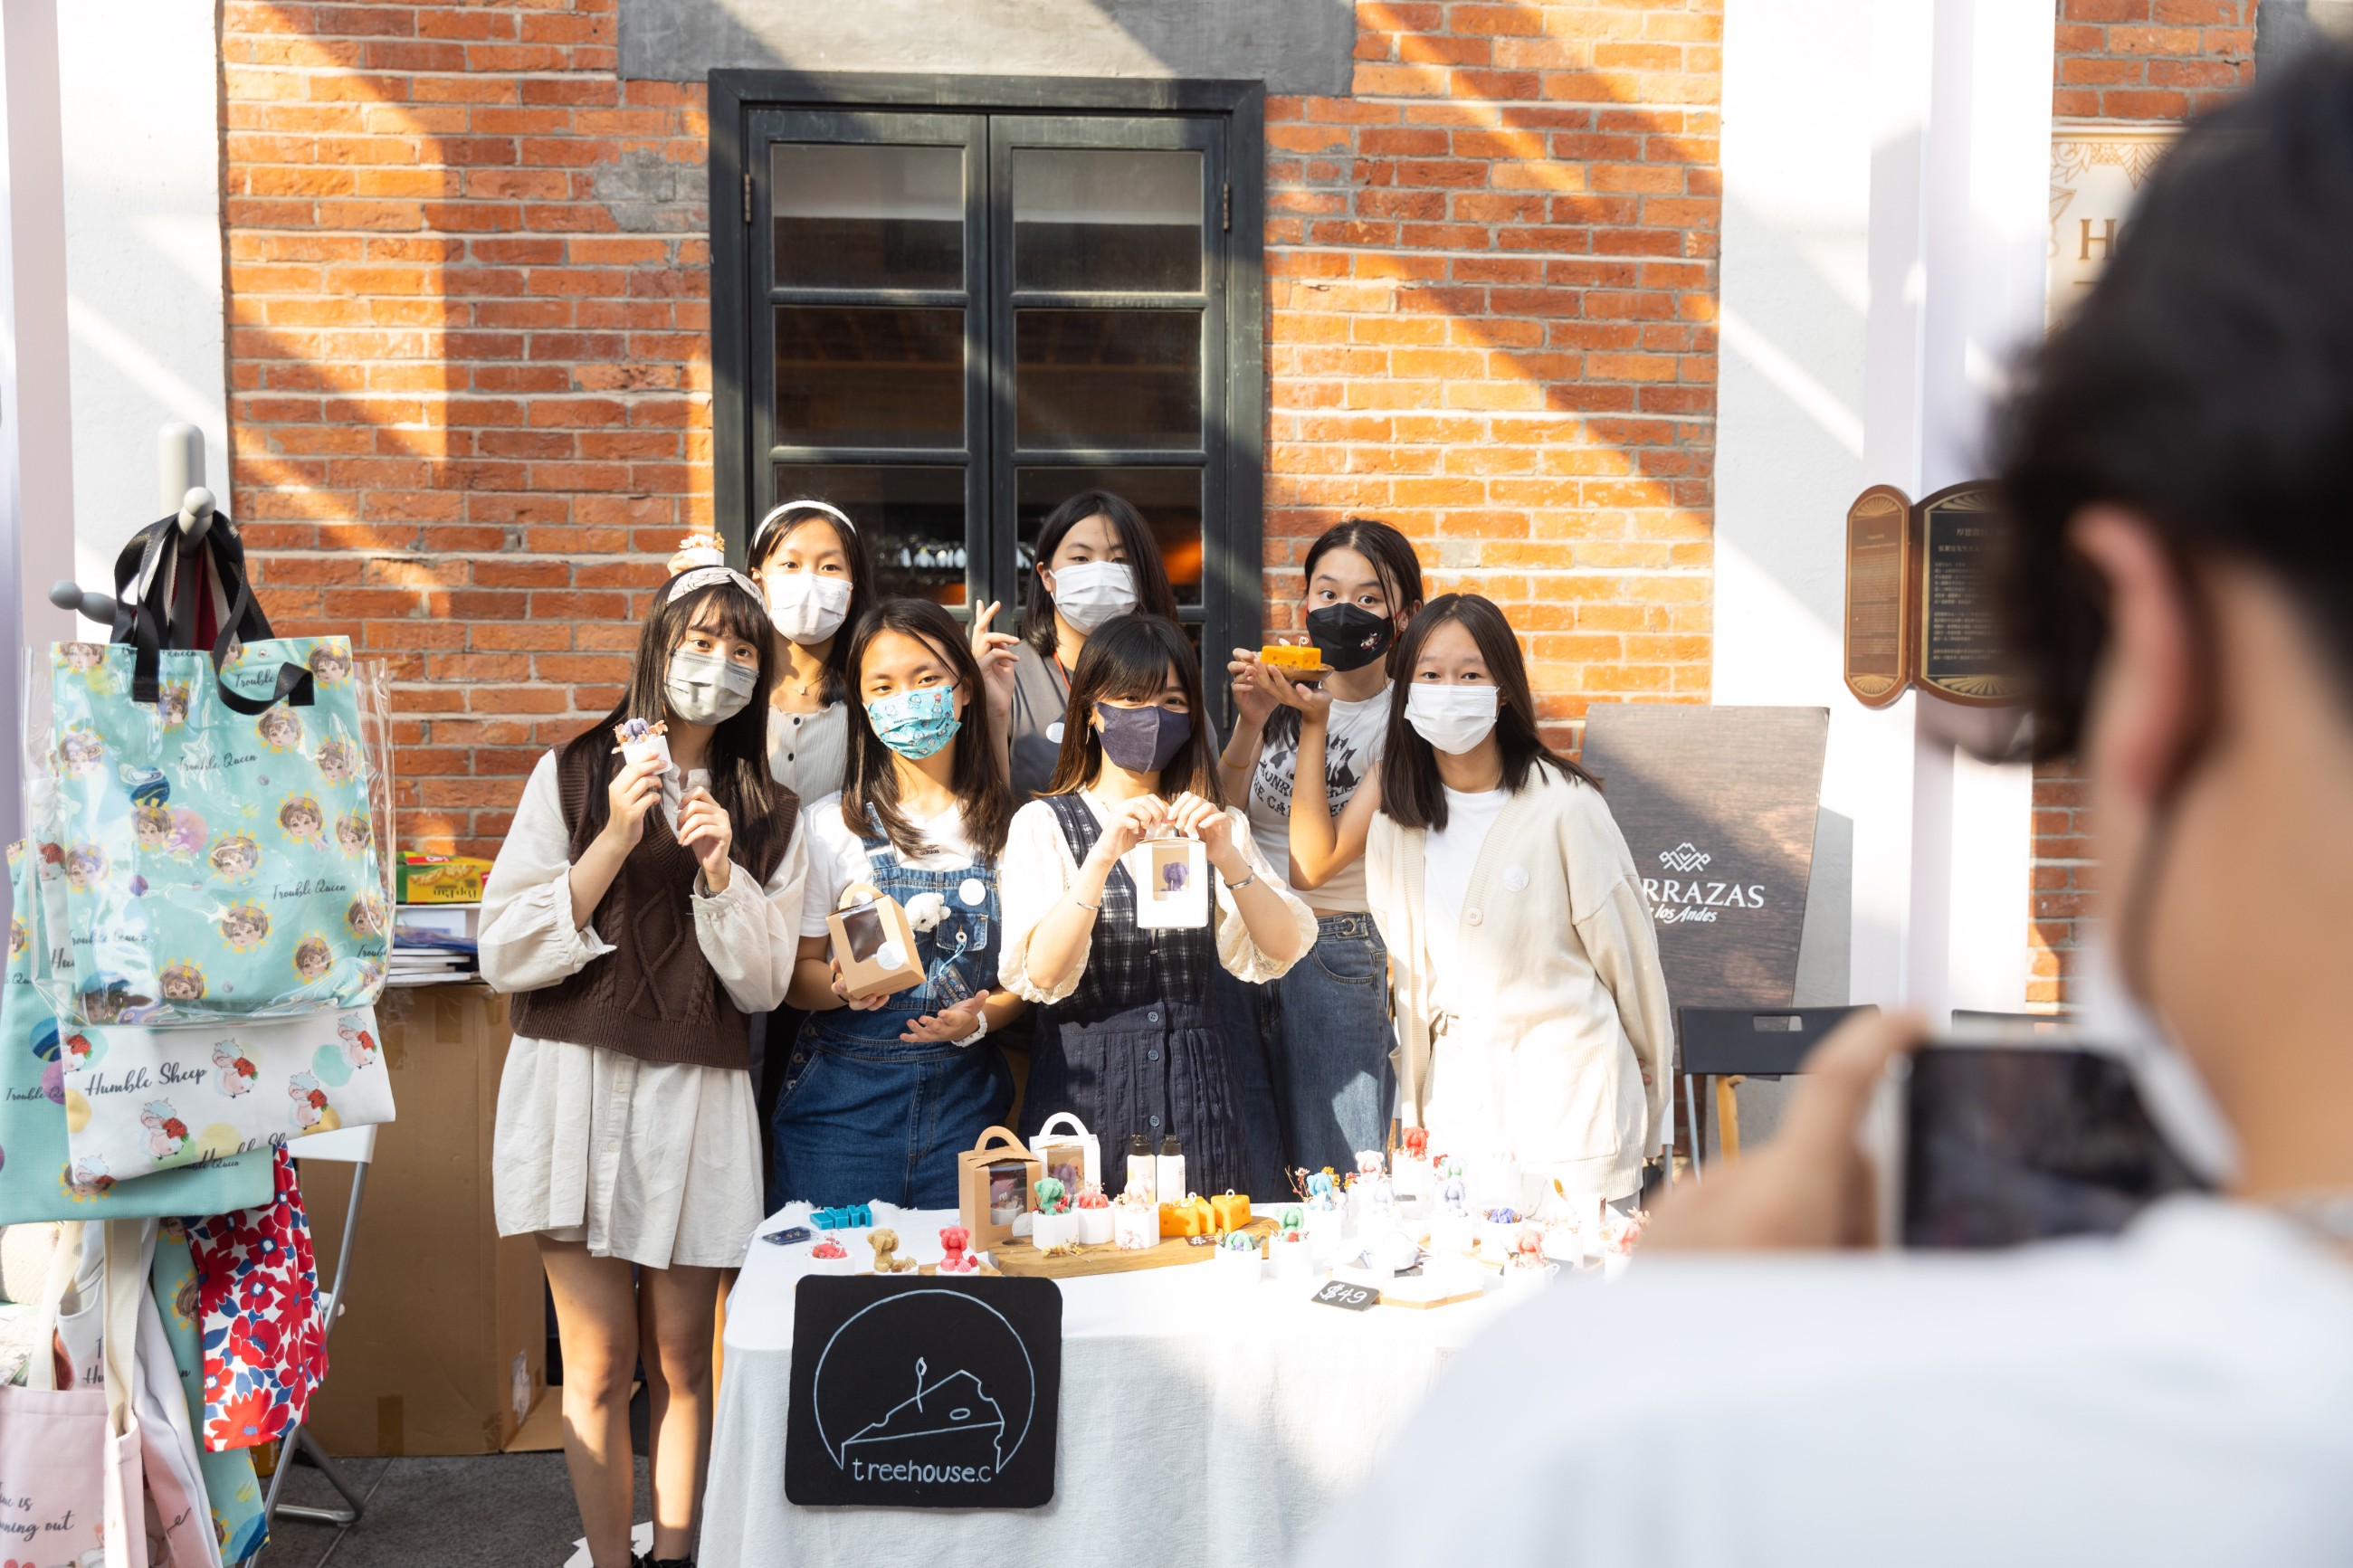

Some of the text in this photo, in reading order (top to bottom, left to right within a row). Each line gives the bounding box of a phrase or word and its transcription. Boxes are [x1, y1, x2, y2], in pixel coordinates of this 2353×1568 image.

[235, 669, 275, 688] Trouble
[224, 752, 257, 768] Queen
[273, 879, 348, 900] Trouble Queen
[1642, 878, 1766, 908] RRAZAS
[1663, 906, 1718, 924] Andes
[84, 1066, 152, 1097] Humble
[158, 1061, 208, 1087] Sheep
[5, 1087, 44, 1101] Trouble
[1319, 1283, 1367, 1304] $49
[852, 1458, 992, 1483] treehouse.c
[44, 1510, 76, 1532] out
